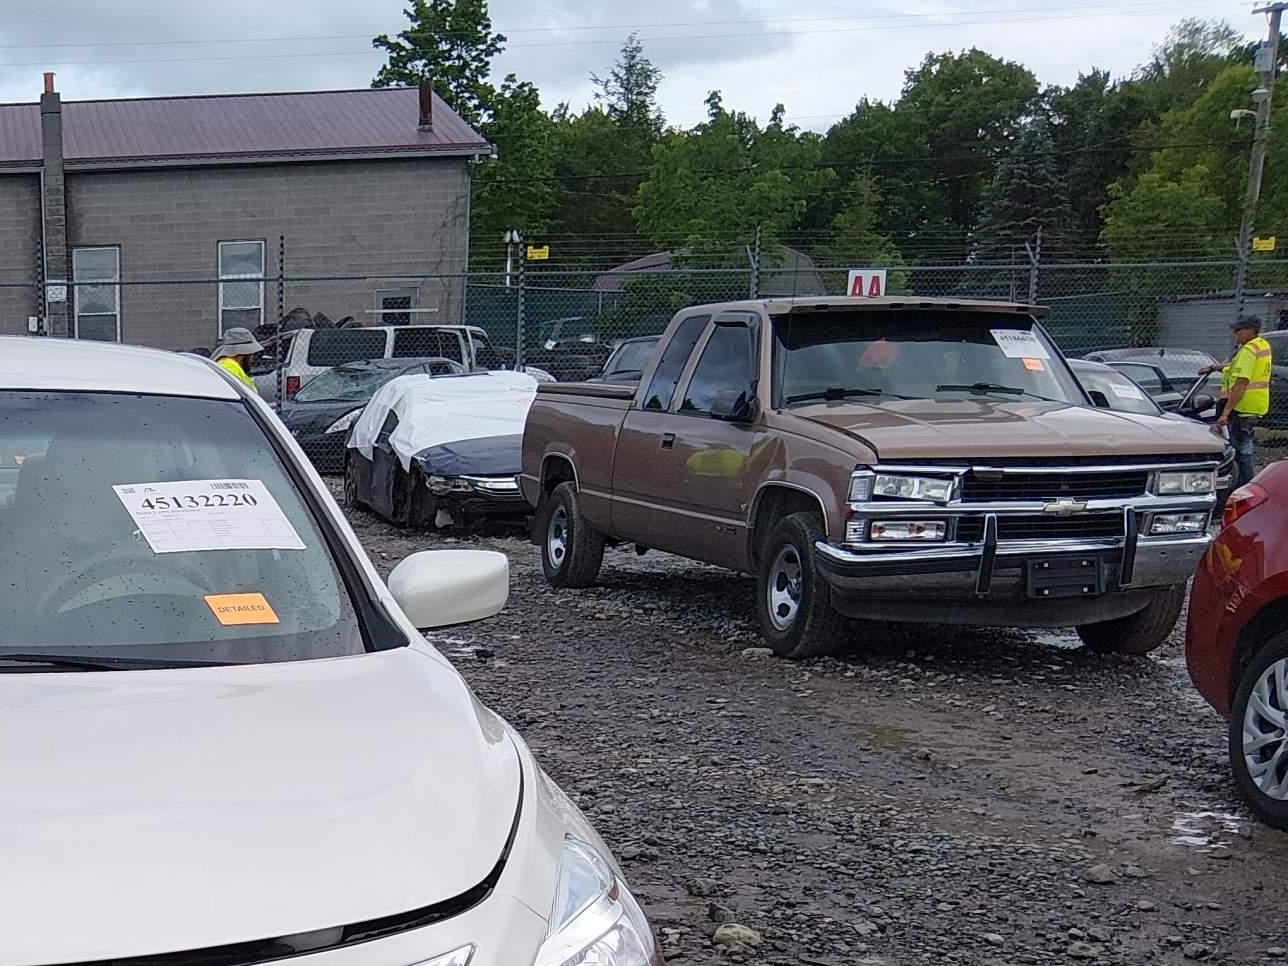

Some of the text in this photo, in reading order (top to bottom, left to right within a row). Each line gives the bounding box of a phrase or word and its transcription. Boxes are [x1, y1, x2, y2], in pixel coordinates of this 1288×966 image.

[852, 276, 880, 297] AA
[142, 494, 257, 510] 45132220
[217, 604, 264, 613] DETAILED
